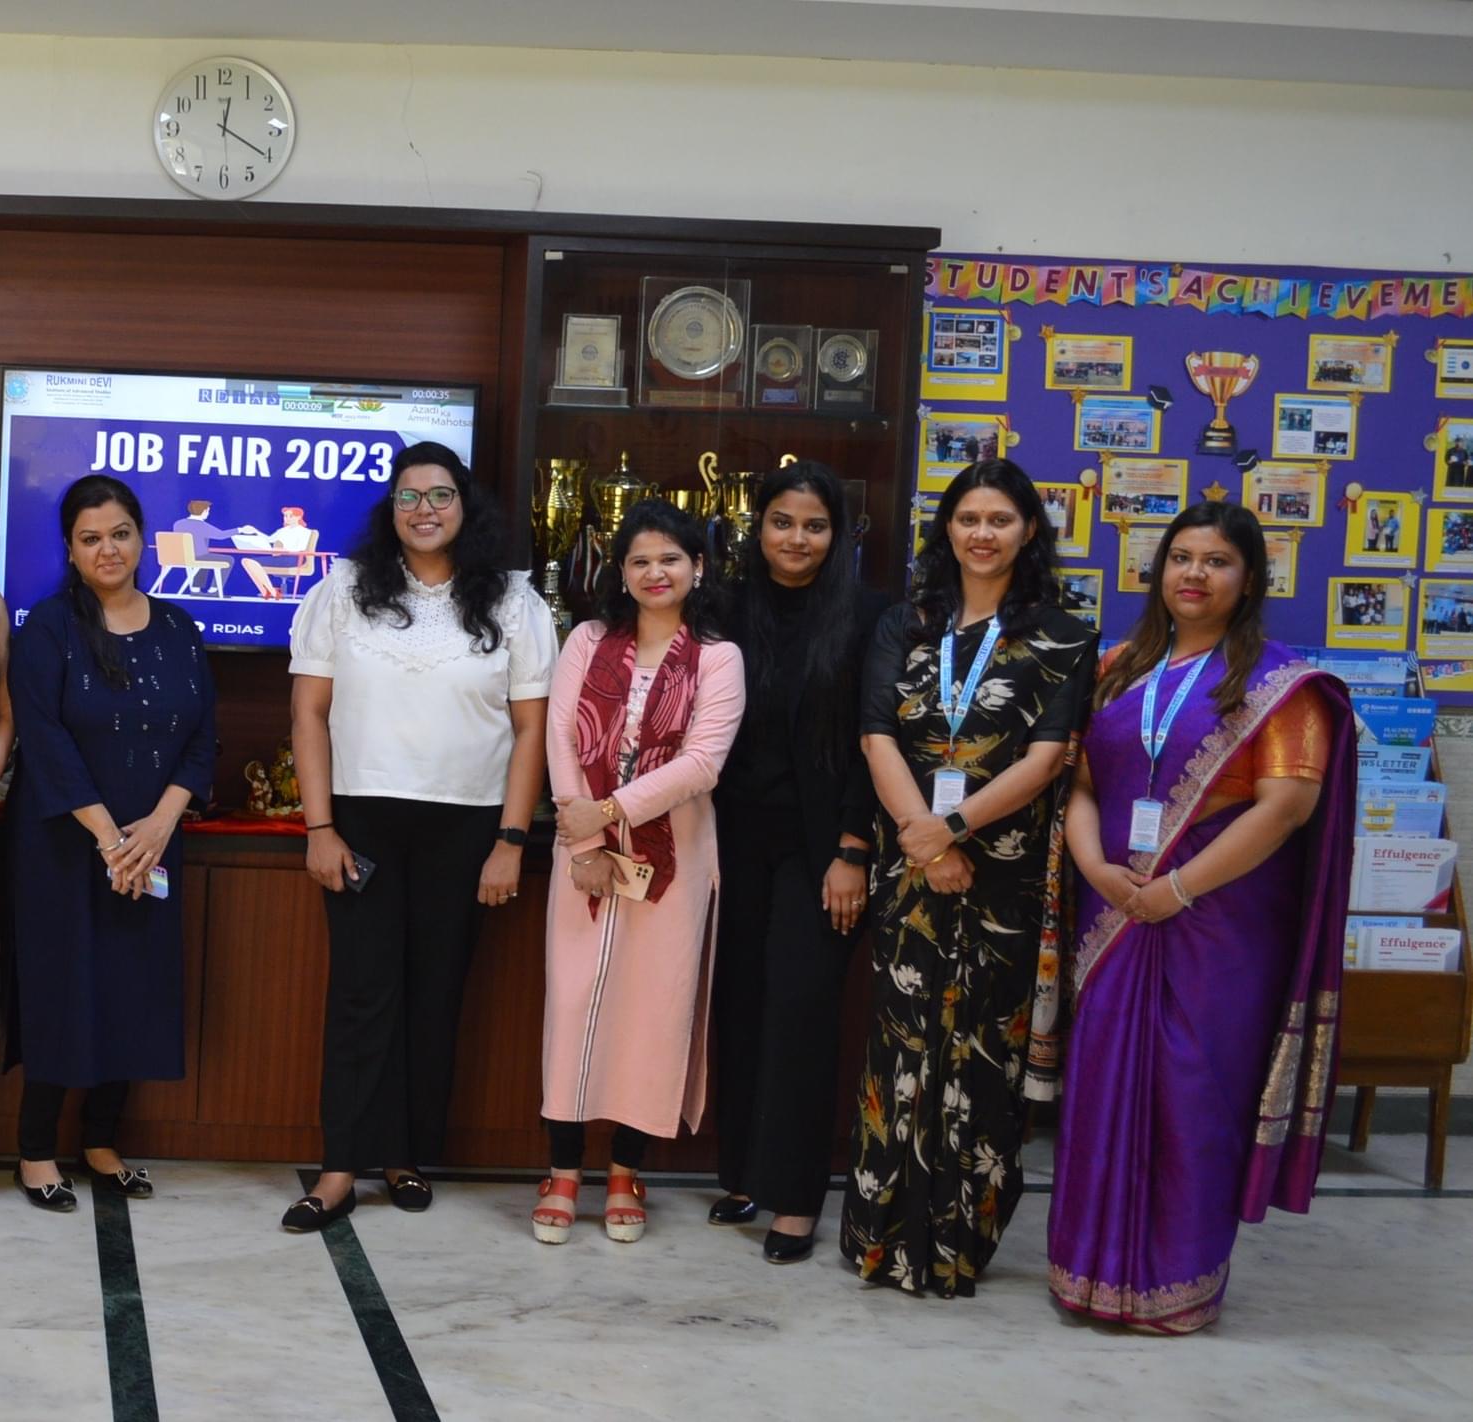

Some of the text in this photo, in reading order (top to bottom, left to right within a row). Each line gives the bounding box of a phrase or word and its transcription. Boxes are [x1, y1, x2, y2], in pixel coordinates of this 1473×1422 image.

[217, 68, 232, 85] 12
[194, 75, 207, 100] 11
[244, 75, 250, 100] 1
[176, 96, 192, 113] 10
[263, 94, 274, 111] 2
[165, 120, 180, 138] 9
[174, 146, 186, 162] 8
[263, 146, 273, 163] 4
[193, 165, 203, 183] 7
[218, 164, 229, 189] 6
[244, 166, 255, 183] 5
[46, 374, 112, 388] RUKMINI DEVI
[90, 430, 394, 483] JOB FAIR 2023
[212, 623, 264, 635] RDIAS
[1372, 848, 1441, 862] Effulgence
[1379, 937, 1447, 950] Effulgence
